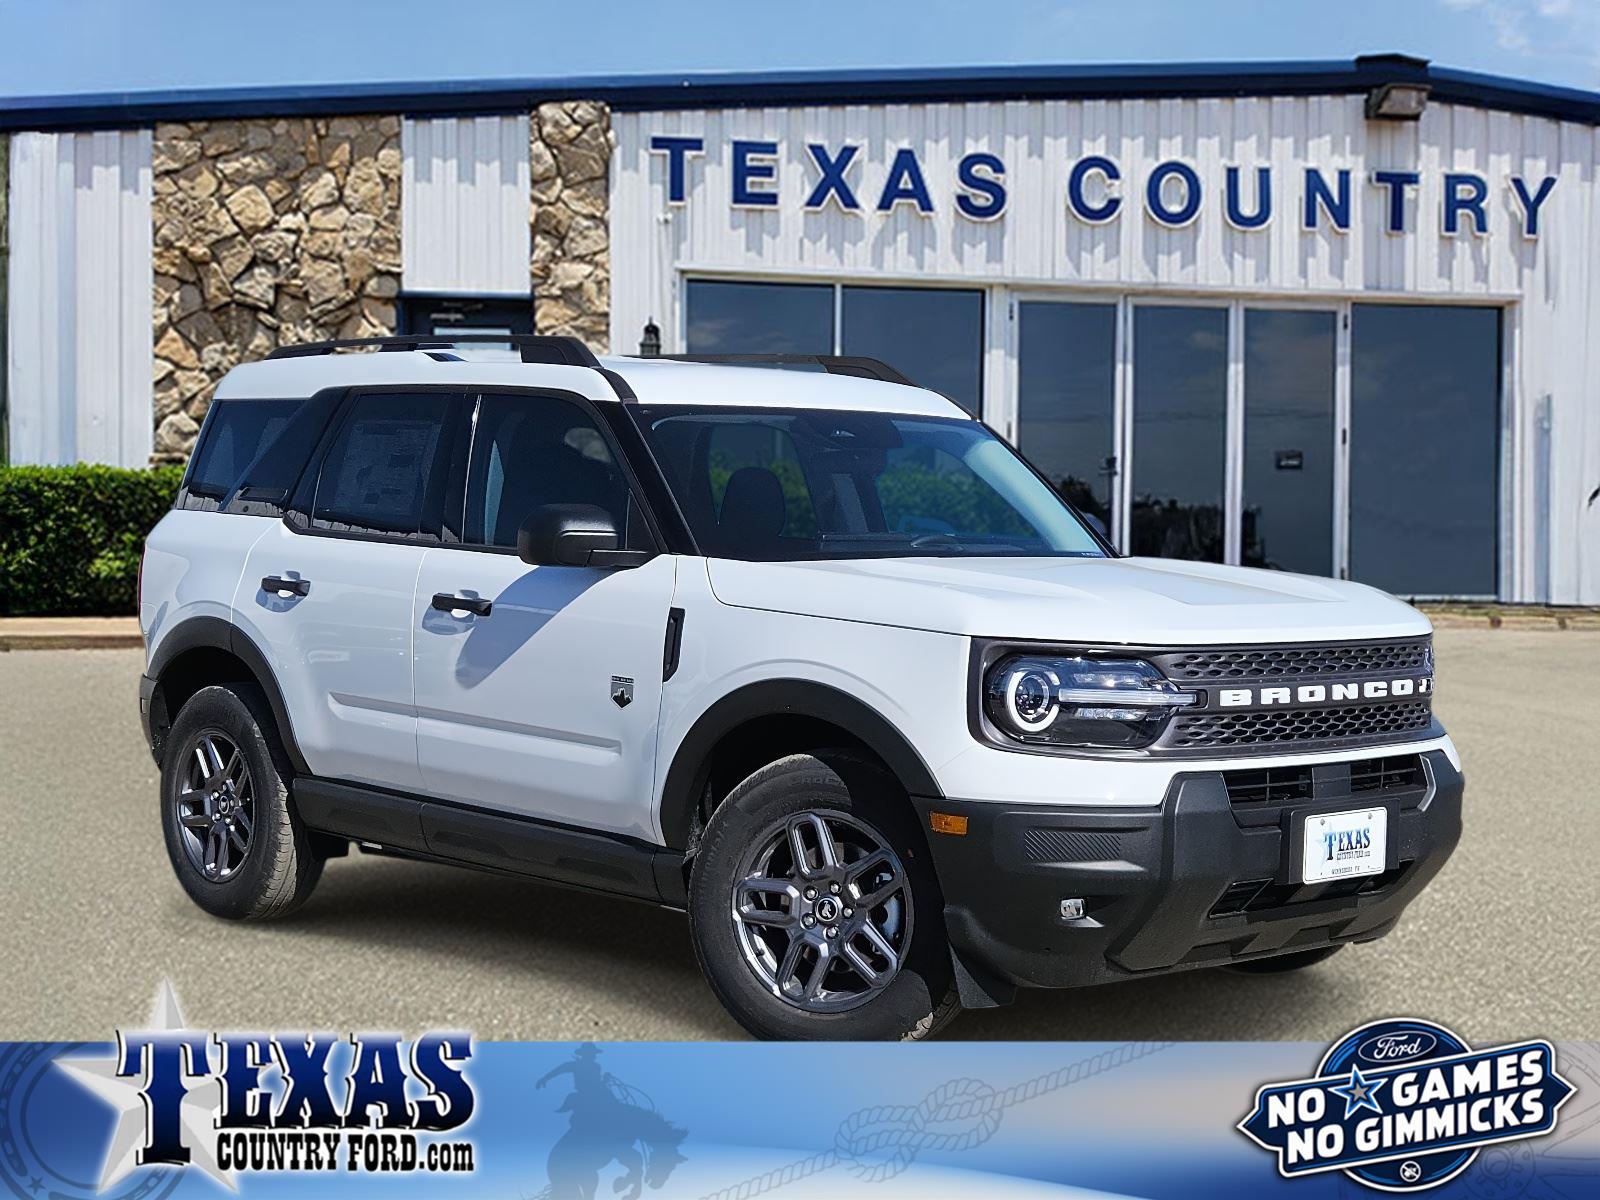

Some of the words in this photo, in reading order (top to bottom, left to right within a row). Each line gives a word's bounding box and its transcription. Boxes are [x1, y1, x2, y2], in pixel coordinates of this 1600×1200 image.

[651, 136, 1008, 220] TEXAS
[1067, 155, 1557, 237] COUNTRY
[1219, 679, 1414, 706] BRONCO
[1323, 828, 1371, 861] TEXAS
